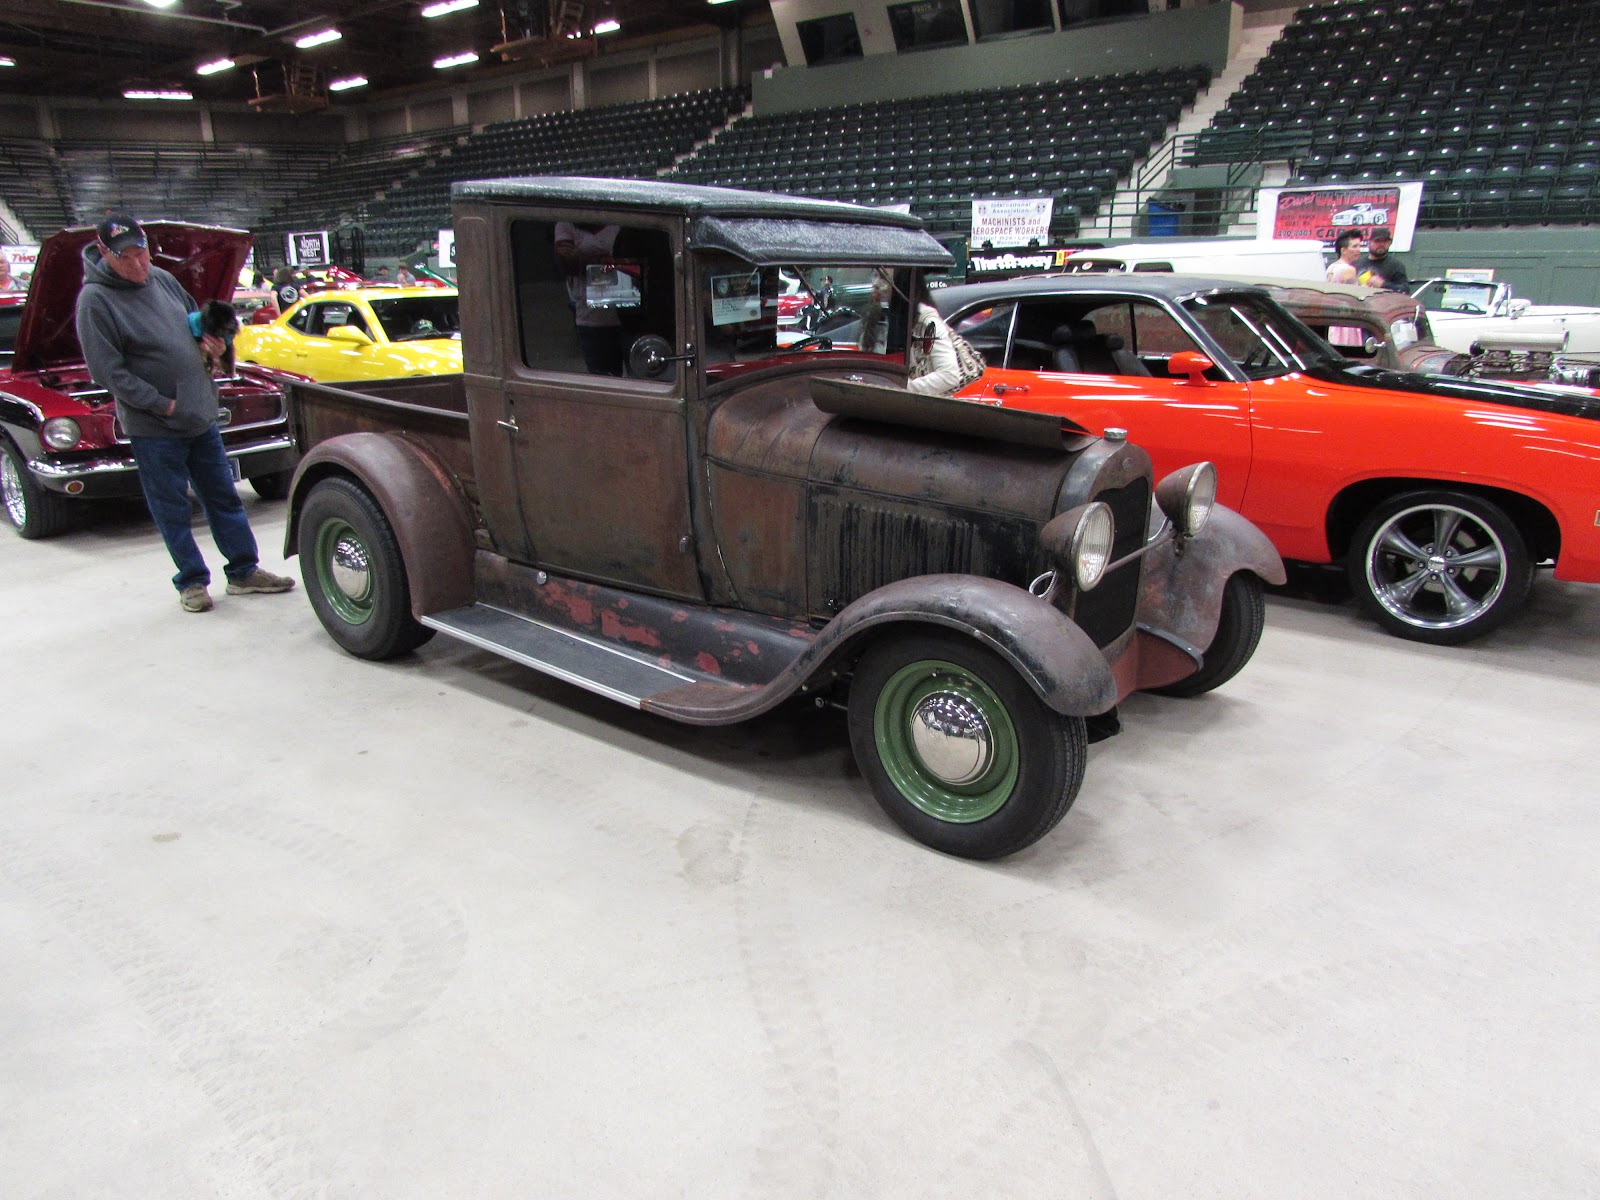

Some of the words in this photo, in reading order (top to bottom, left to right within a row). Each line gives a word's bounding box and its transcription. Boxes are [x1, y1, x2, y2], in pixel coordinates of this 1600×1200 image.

[982, 218, 1026, 226] MACHINISTS
[973, 227, 1013, 235] AEROSPACE
[1015, 226, 1048, 235] WORKERS
[301, 236, 320, 248] NORTH
[300, 248, 320, 257] WEST
